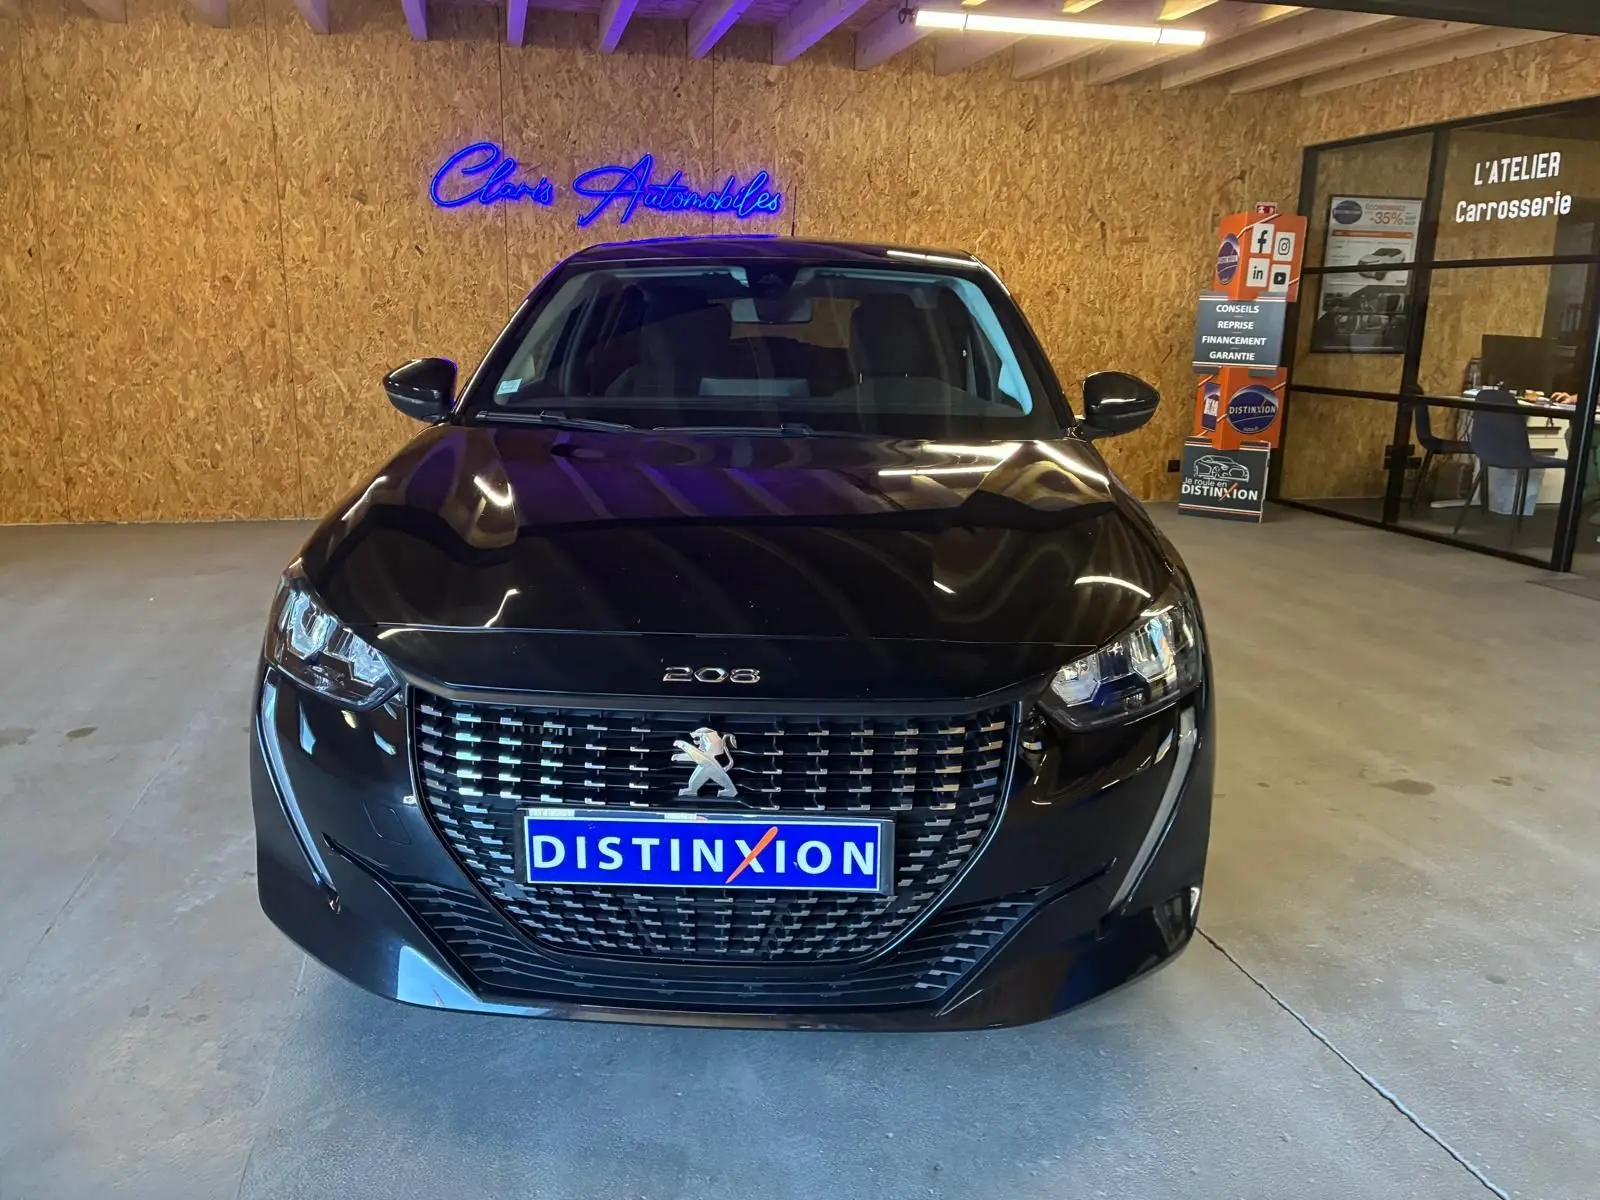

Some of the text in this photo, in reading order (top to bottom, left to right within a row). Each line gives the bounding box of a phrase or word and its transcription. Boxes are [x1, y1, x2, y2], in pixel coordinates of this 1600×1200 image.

[1474, 151, 1561, 186] L'ATELIER
[430, 142, 782, 226] Claris Automobiles
[1455, 190, 1572, 223] Carrosserie
[1252, 266, 1263, 279] in
[1216, 304, 1259, 313] CONSEILS
[1217, 320, 1254, 330] REPRISE
[1201, 335, 1267, 346] FINANCEMENT
[1209, 351, 1256, 361] GARANTIE
[1229, 405, 1276, 415] DISTINXION
[1194, 478, 1215, 487] roule
[1216, 480, 1228, 488] en
[1181, 483, 1258, 501] DISTINXION
[662, 666, 760, 684] 208
[531, 826, 874, 884] DISTINXION
